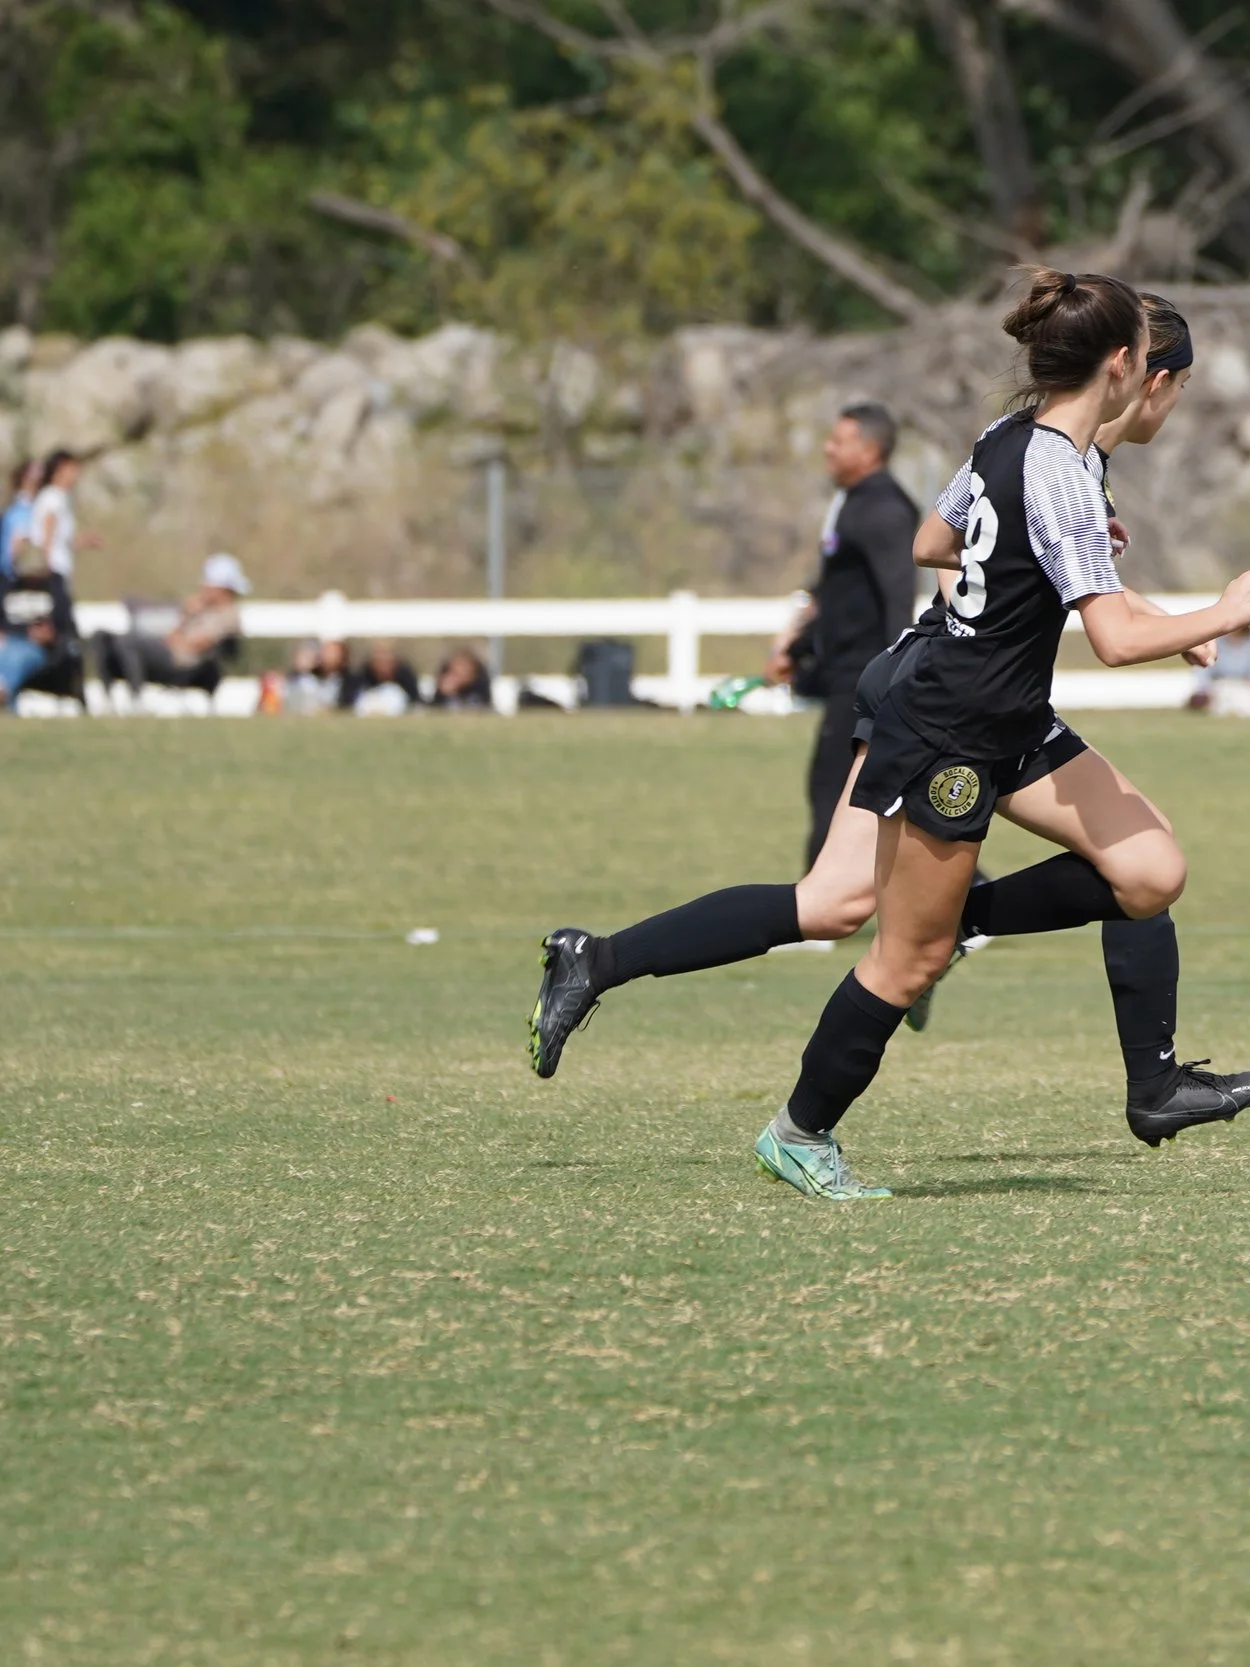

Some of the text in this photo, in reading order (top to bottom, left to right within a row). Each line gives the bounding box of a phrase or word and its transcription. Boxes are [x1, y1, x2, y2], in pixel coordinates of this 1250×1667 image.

[943, 768, 966, 778] SOCAL
[930, 786, 972, 815] FOOTBALL CLUB
